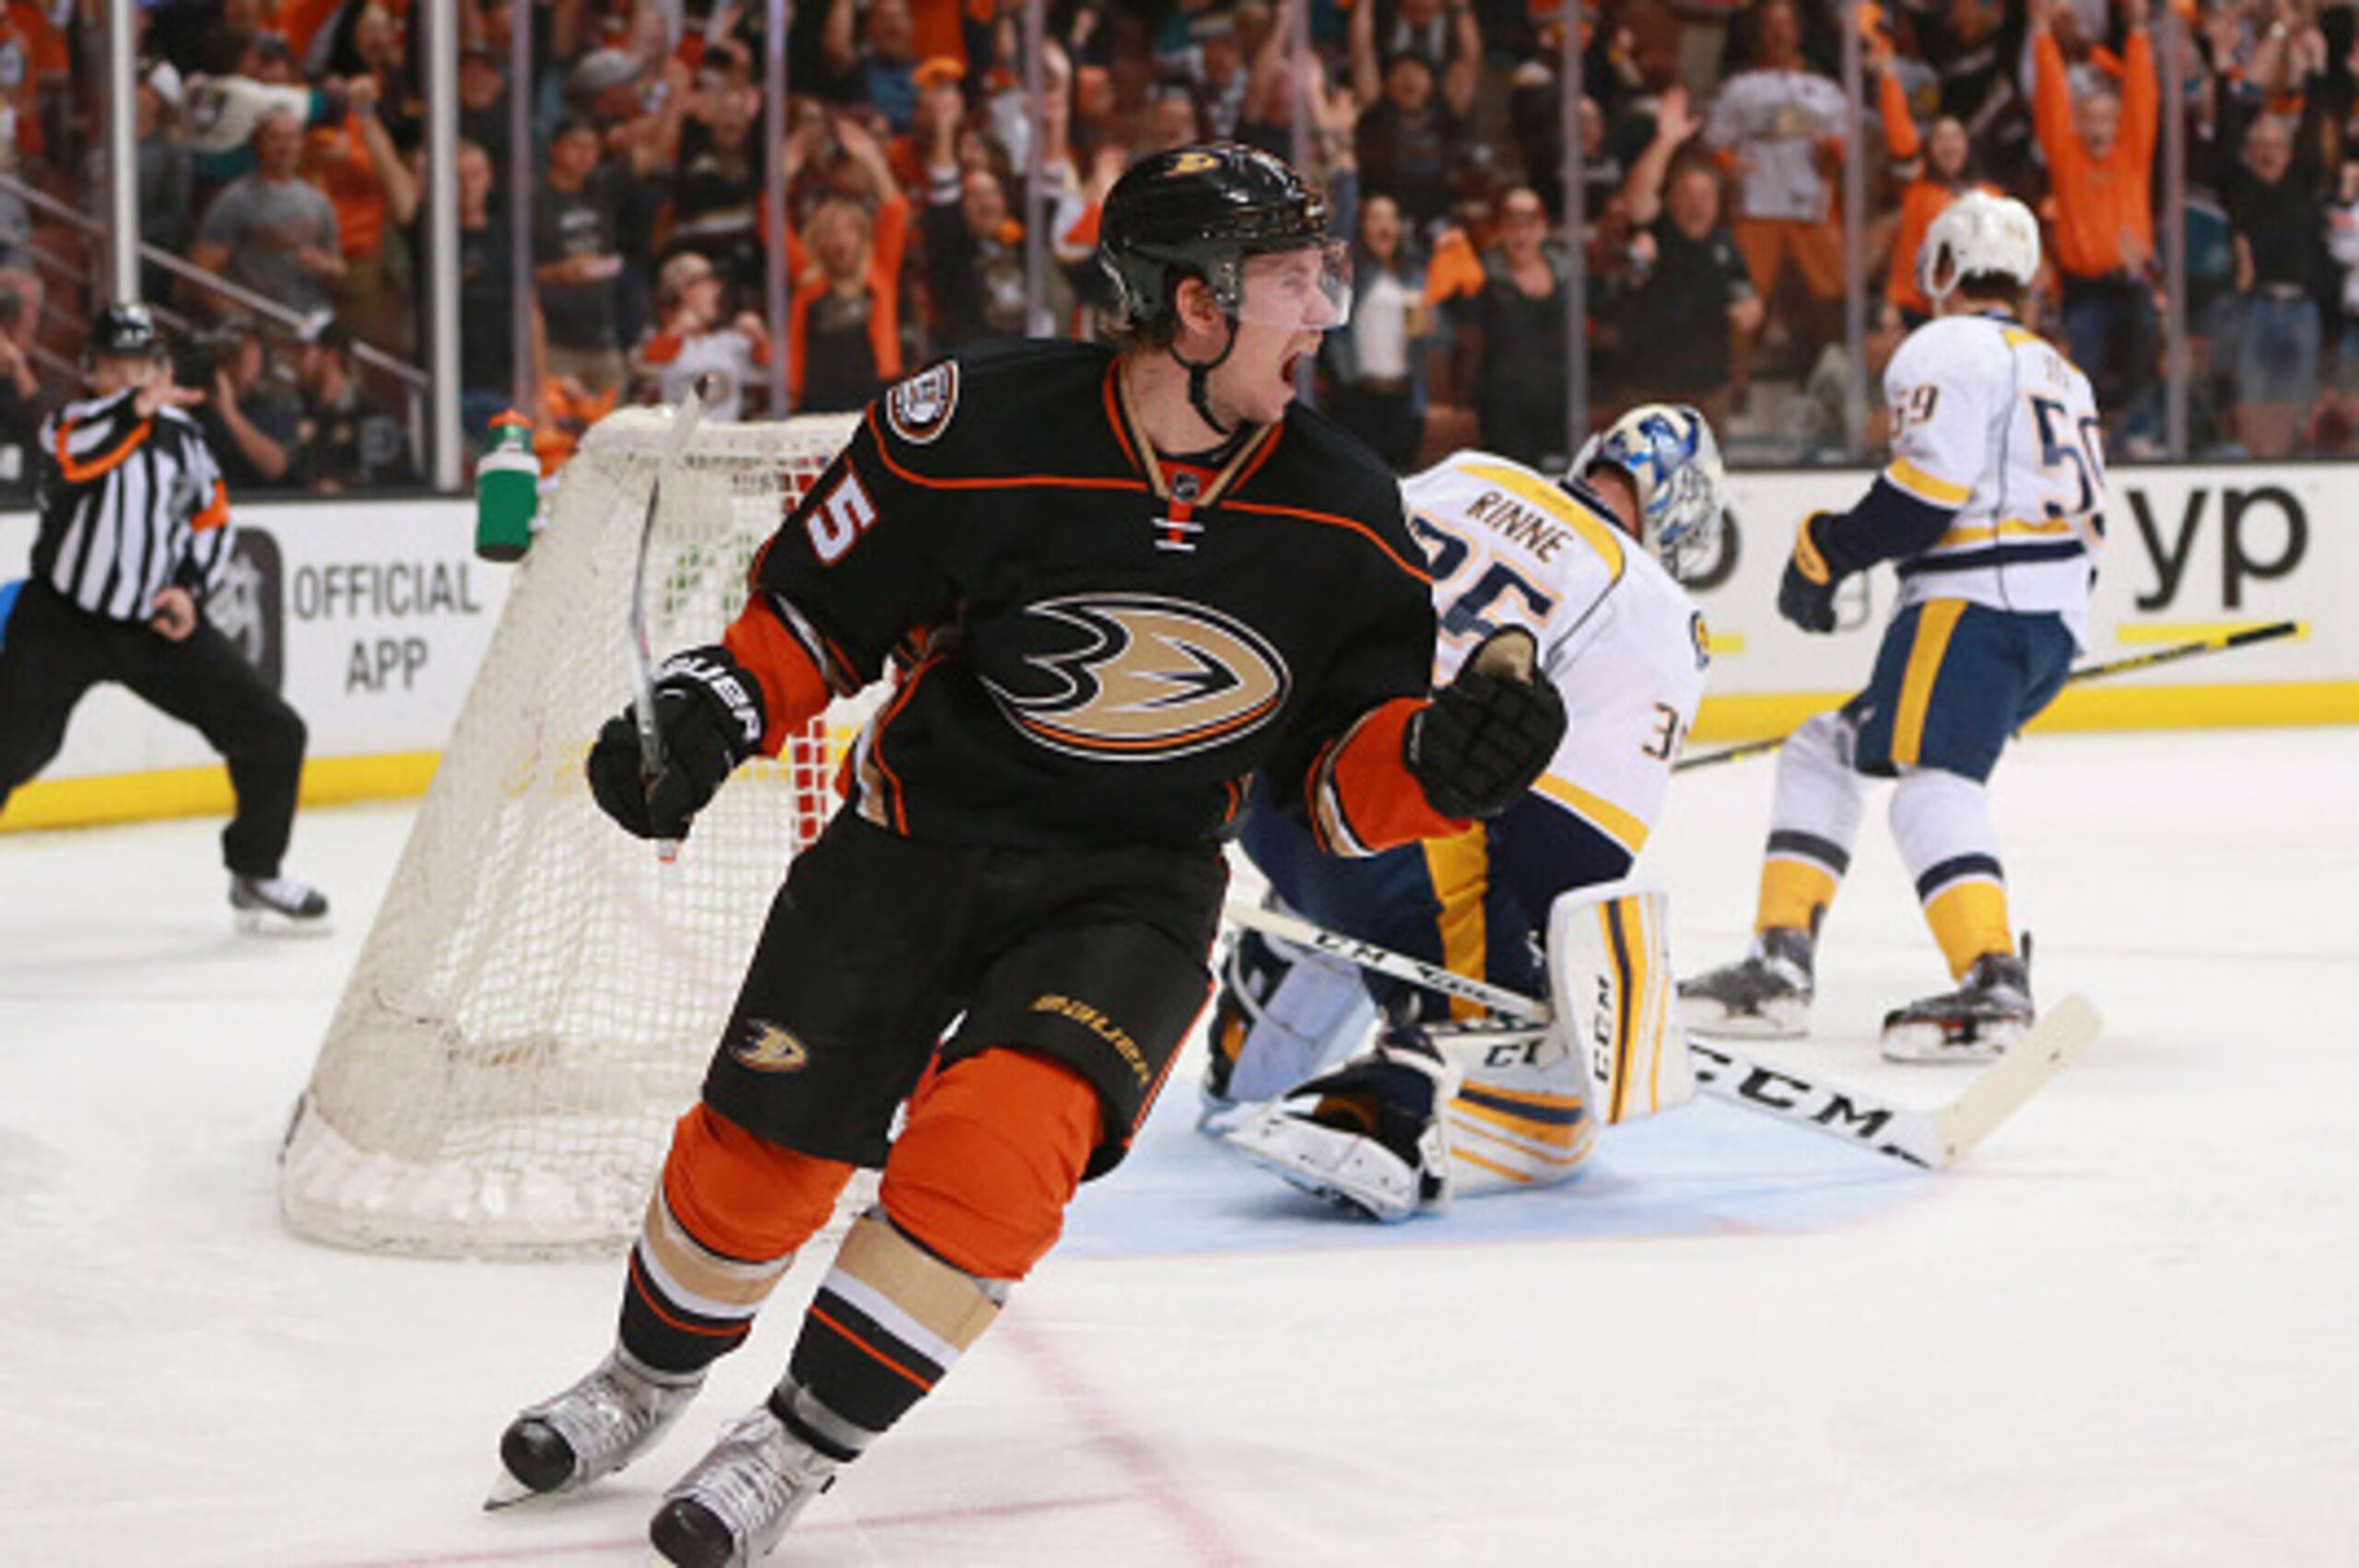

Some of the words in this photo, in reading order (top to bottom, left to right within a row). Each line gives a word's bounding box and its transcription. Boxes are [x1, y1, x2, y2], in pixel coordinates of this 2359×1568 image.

[805, 472, 877, 566] 5
[1464, 490, 1574, 565] RINNE
[294, 561, 481, 621] OFFICIAL
[346, 637, 428, 694] APP
[1642, 701, 1688, 761] 3
[1594, 975, 1613, 1084] CCM
